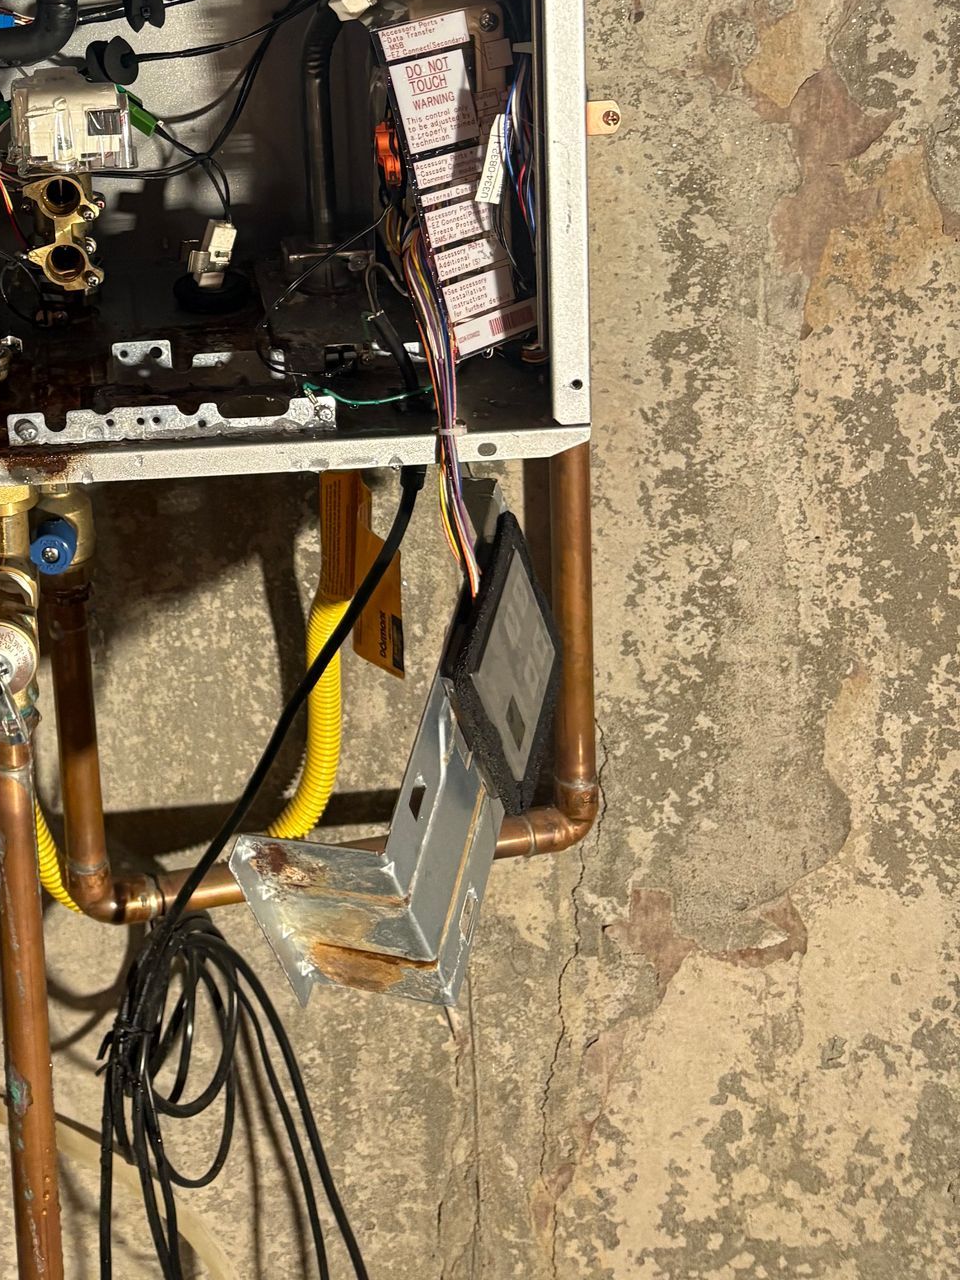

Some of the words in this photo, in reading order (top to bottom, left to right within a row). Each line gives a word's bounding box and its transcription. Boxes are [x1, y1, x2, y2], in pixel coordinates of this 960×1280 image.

[382, 26, 416, 37] Accessory
[418, 20, 438, 28] Ports
[406, 28, 435, 38] Transfer
[405, 64, 422, 78] DO
[427, 56, 449, 73] NOT
[409, 74, 447, 93] TOUCH
[413, 91, 455, 111] WARNING
[406, 117, 423, 125] This
[425, 108, 450, 120] control
[430, 114, 460, 127] adjusted
[417, 126, 447, 140] properly
[416, 159, 447, 170] Accessory
[428, 210, 457, 221] Accessory
[438, 249, 466, 260] Accessory
[468, 243, 484, 251] Ports
[439, 253, 470, 268] Additional
[441, 262, 471, 277] Controller
[460, 278, 487, 291] accessory
[450, 285, 486, 302] installation
[453, 293, 487, 310] instructions
[465, 302, 485, 312] further
